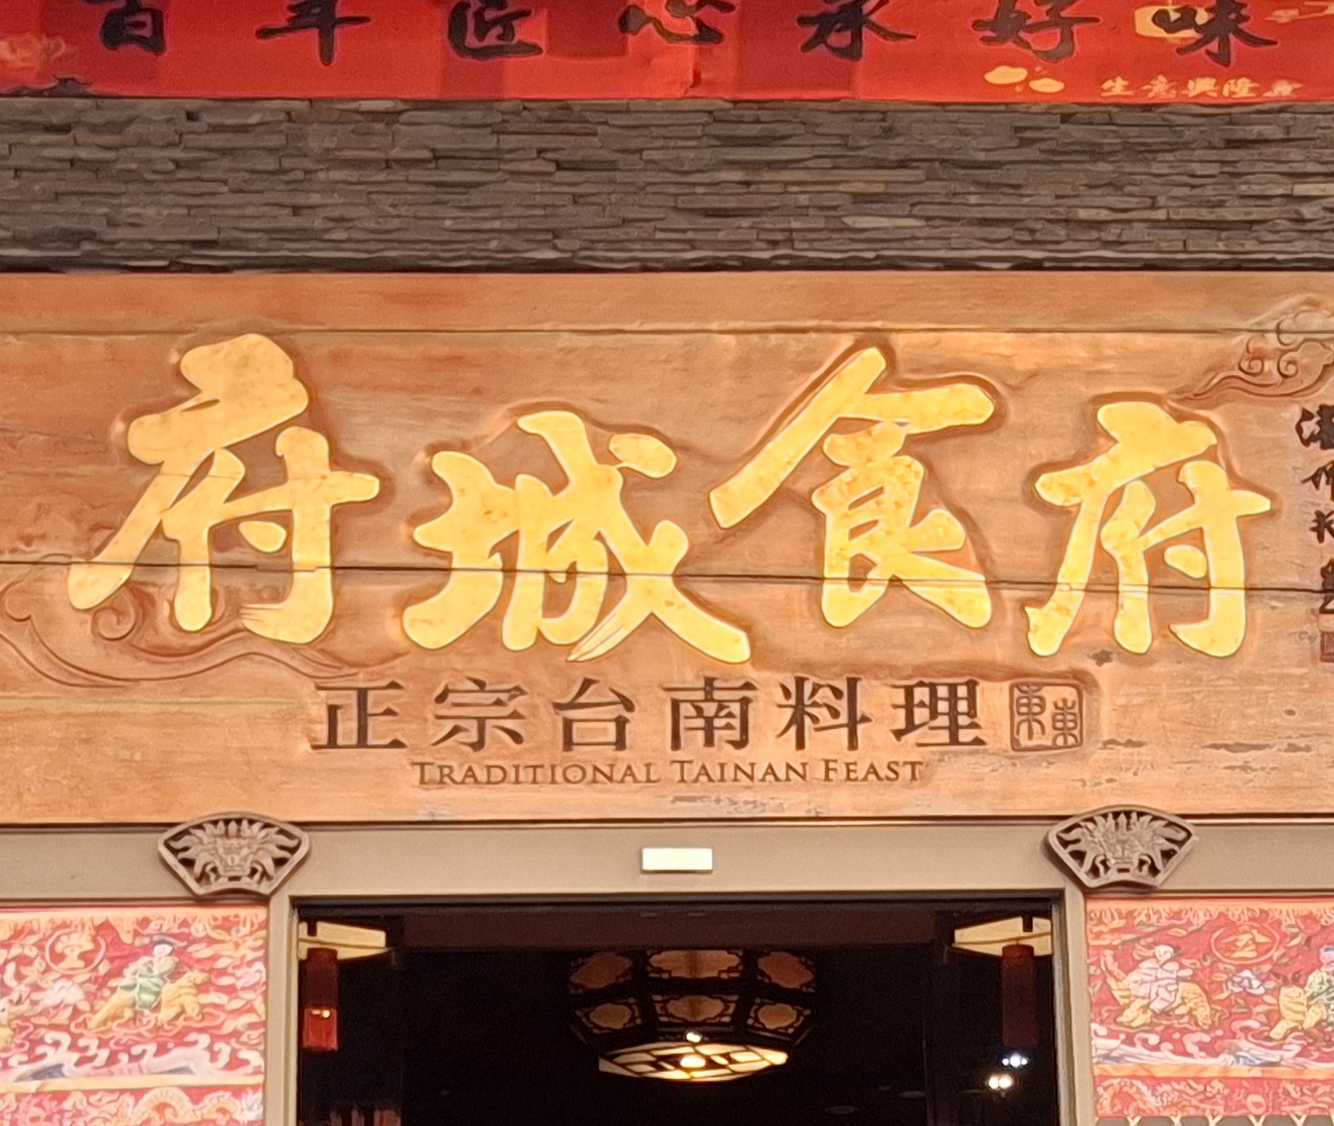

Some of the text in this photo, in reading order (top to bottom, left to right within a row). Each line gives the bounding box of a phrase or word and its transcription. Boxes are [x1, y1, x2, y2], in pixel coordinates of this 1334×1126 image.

[66, 332, 1273, 664] 府城食府
[308, 678, 987, 755] 正宗台南料理
[411, 759, 925, 786] TRADITIONAL TAINAN FEAST
